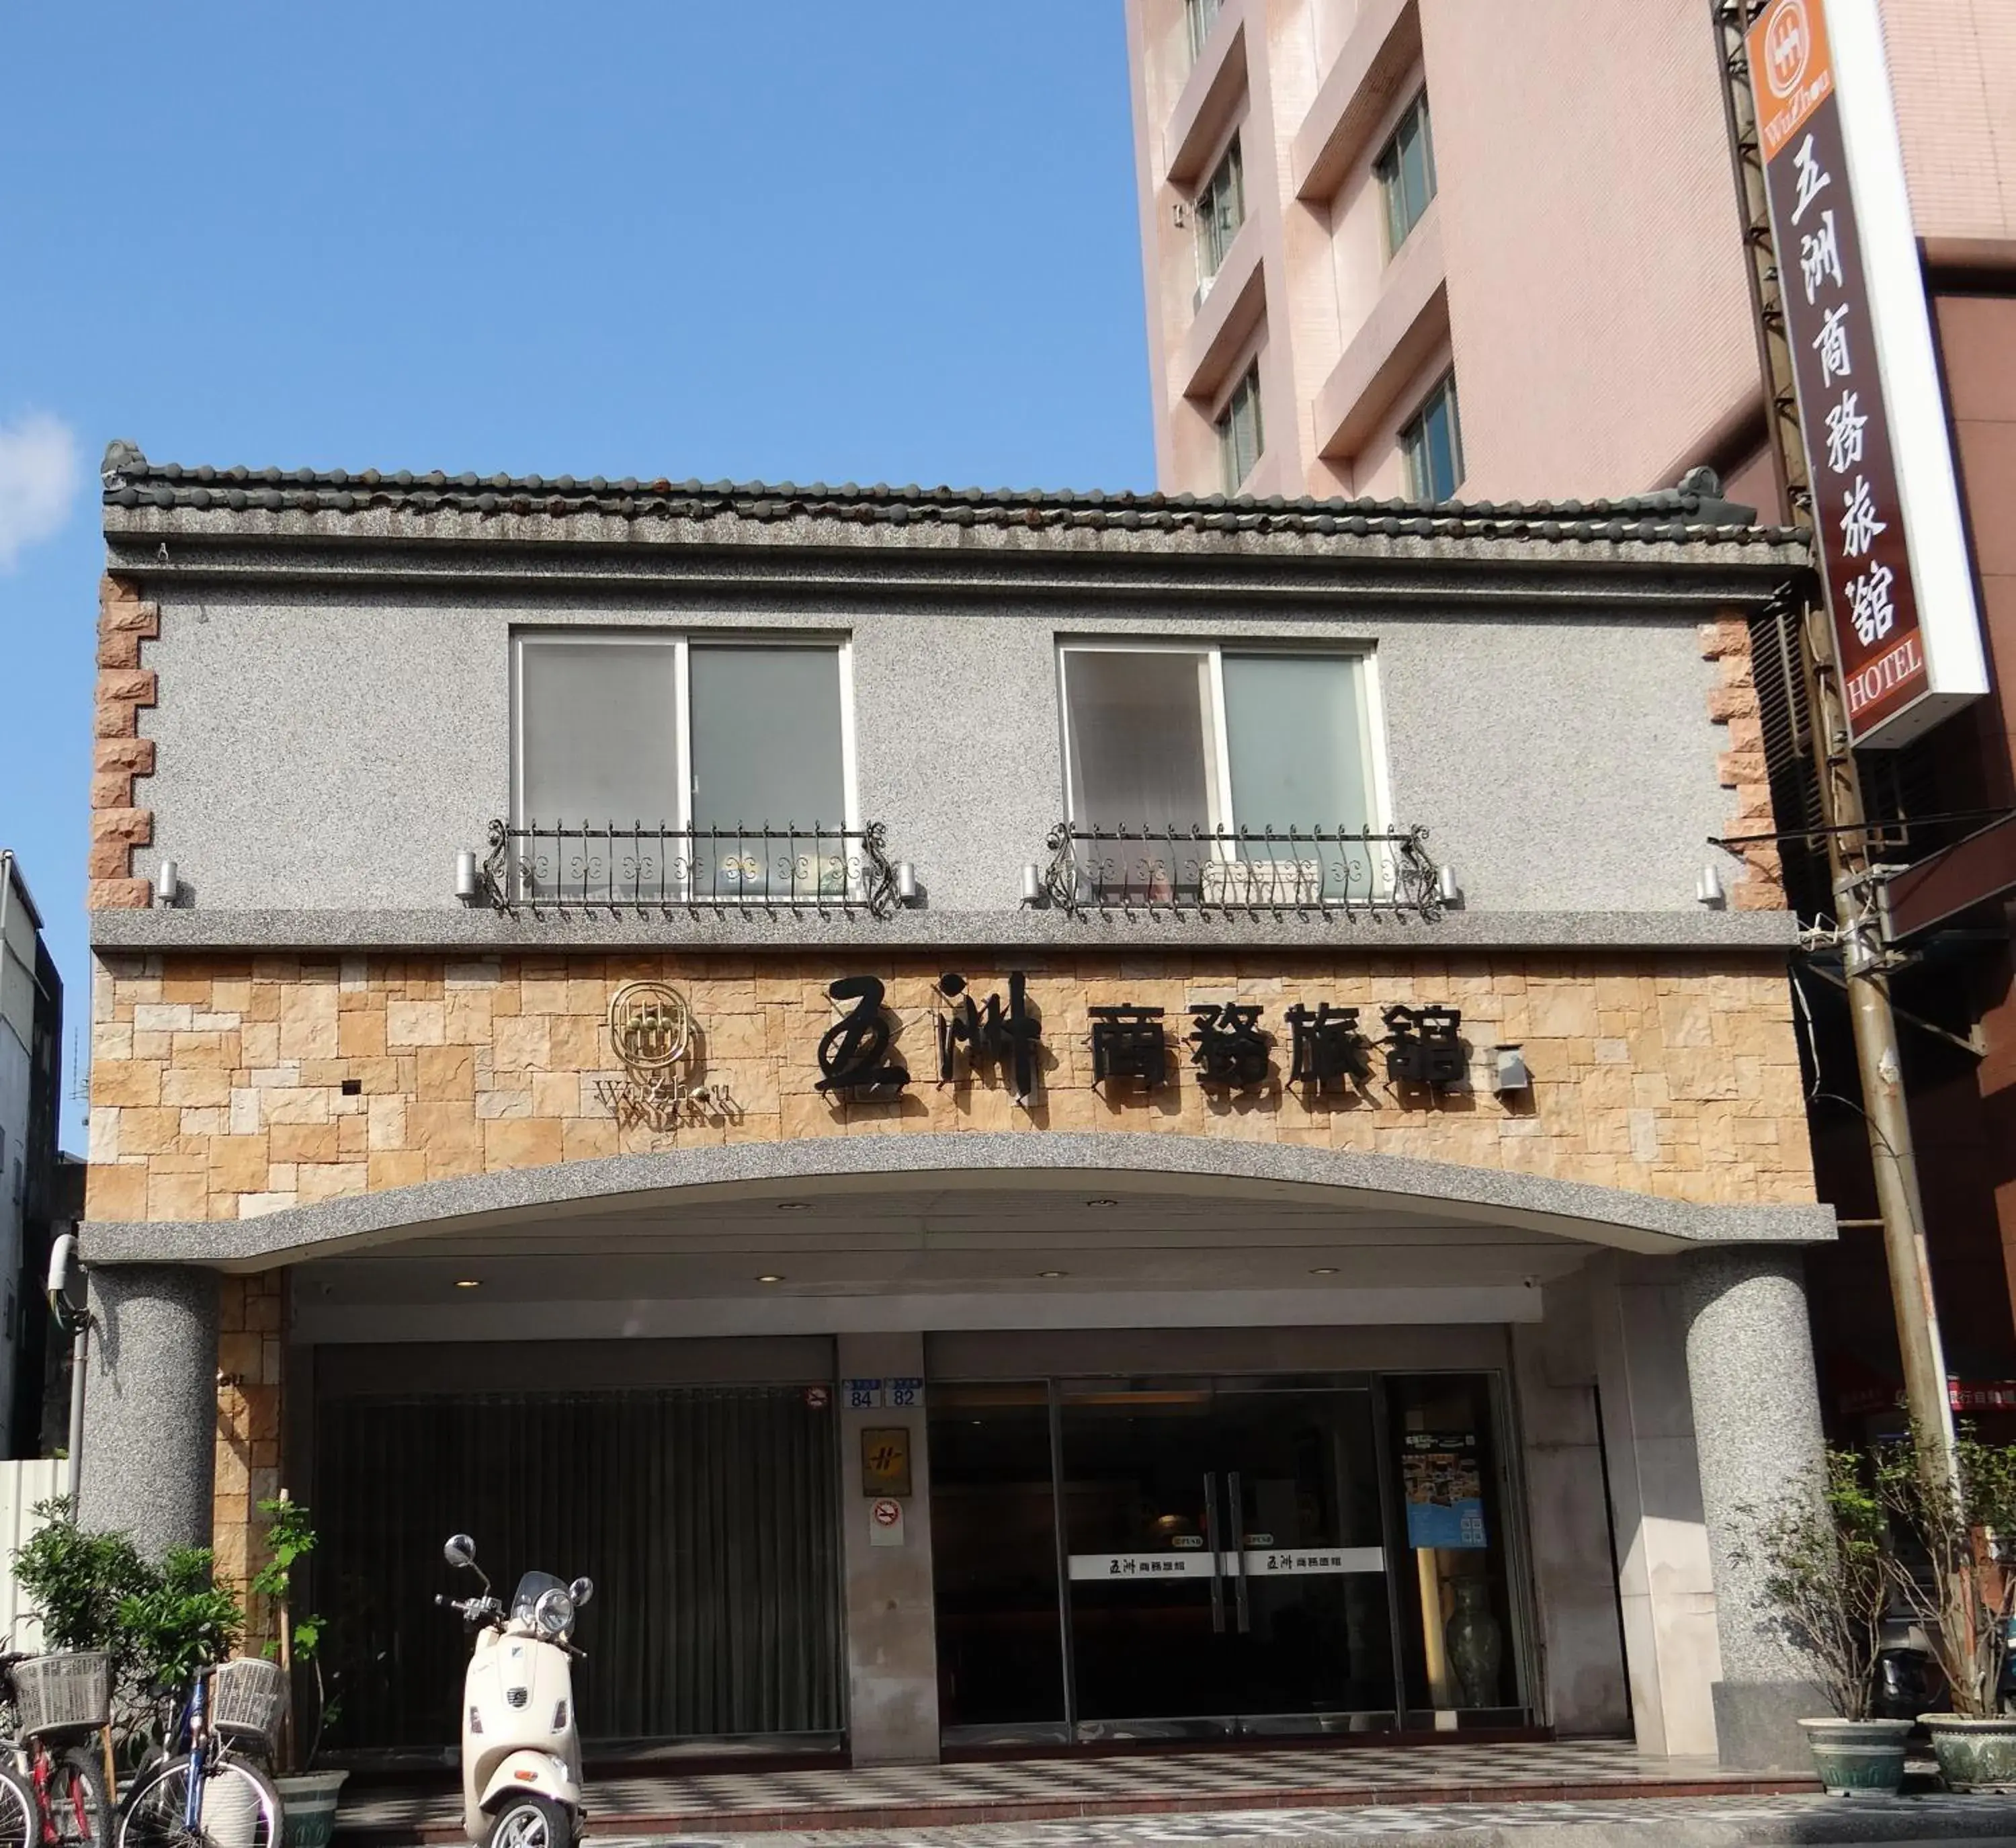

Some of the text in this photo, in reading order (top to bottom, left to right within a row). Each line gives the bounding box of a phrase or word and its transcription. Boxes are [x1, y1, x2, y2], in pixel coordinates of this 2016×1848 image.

[1764, 69, 1831, 147] WuZhou
[1846, 640, 1922, 716] HOTEL
[851, 1390, 872, 1407] 84
[894, 1389, 915, 1405] 82
